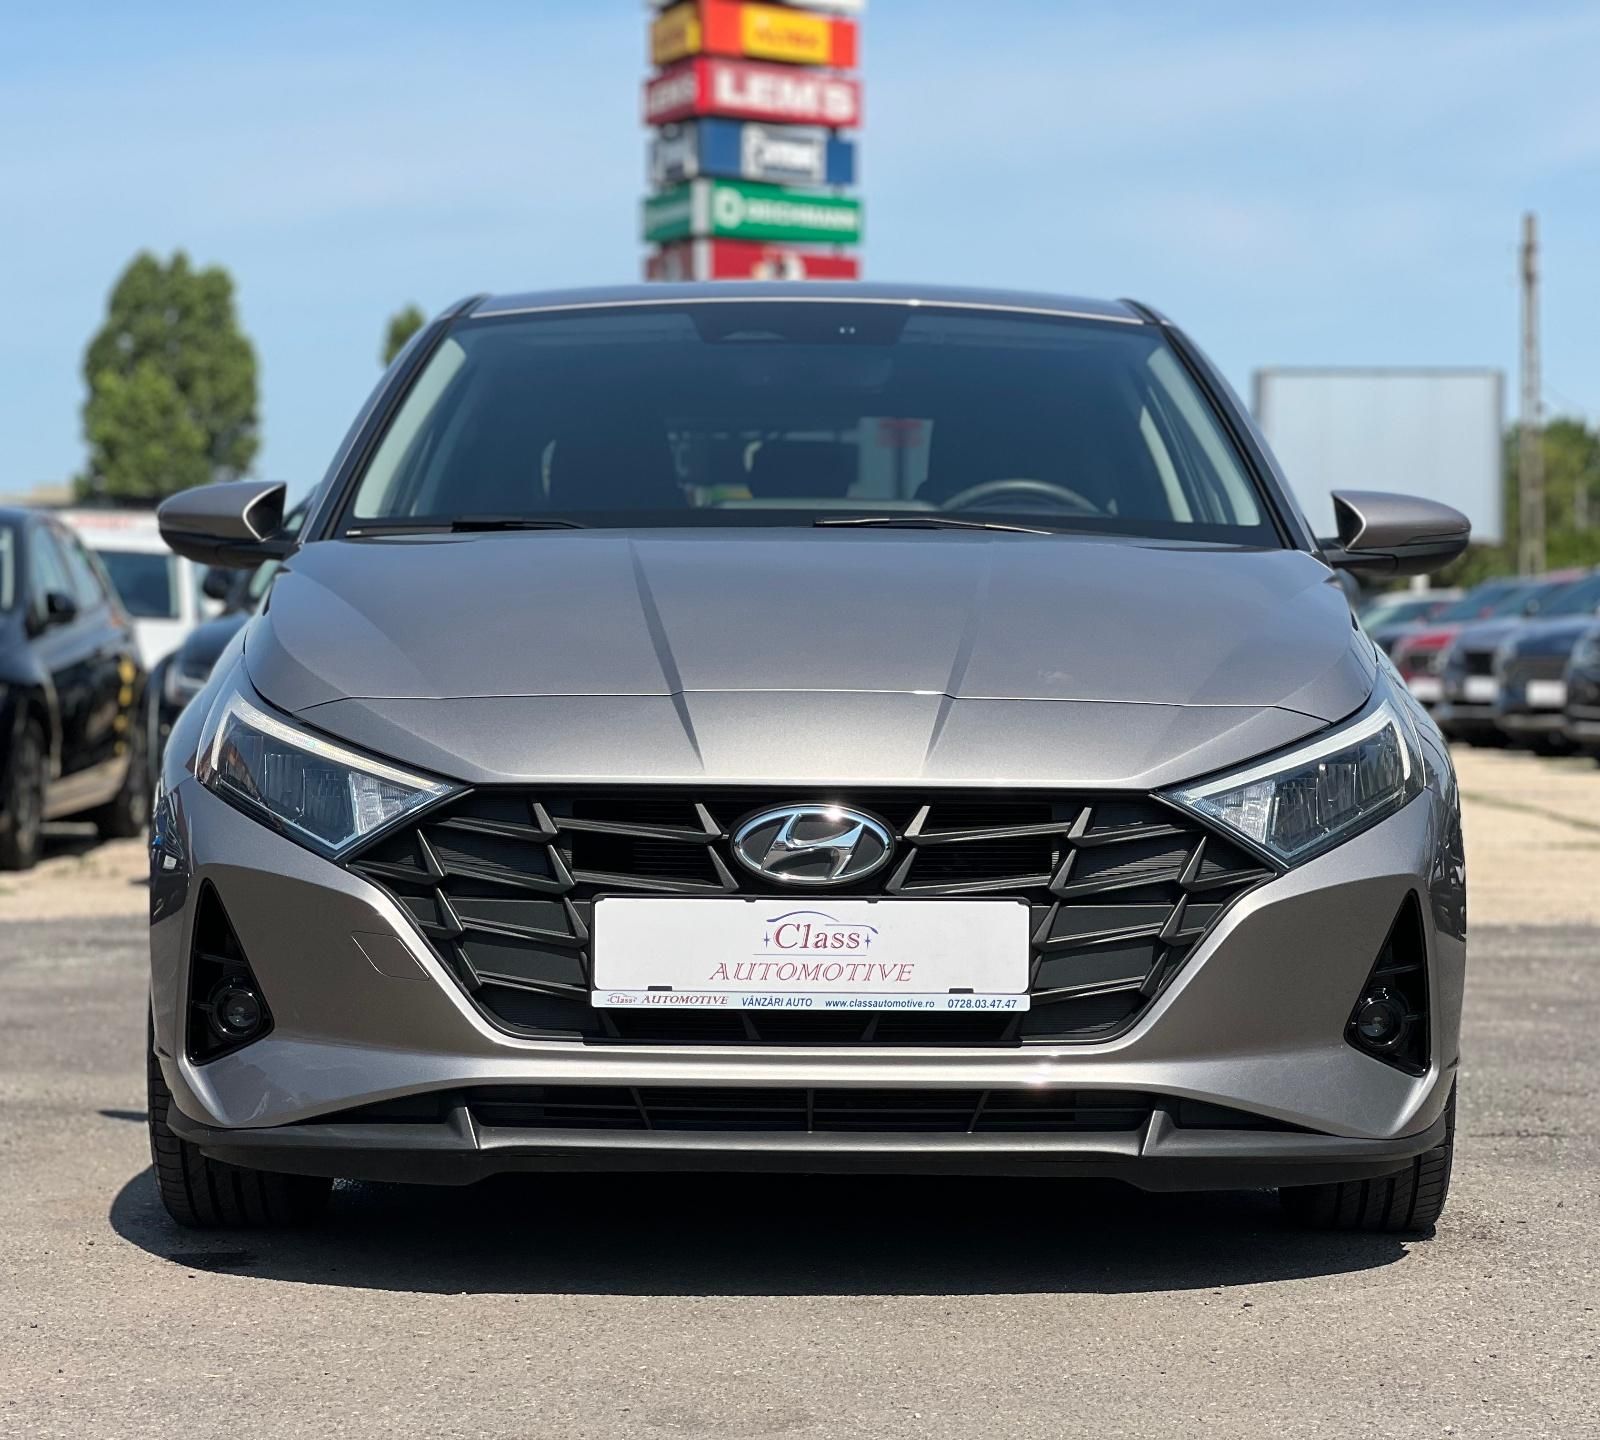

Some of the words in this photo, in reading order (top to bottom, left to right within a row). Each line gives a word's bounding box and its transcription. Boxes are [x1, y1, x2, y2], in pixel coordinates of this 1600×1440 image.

[773, 922, 861, 949] Class
[708, 962, 914, 982] AUTOMOTIVE
[609, 994, 634, 1005] Class
[642, 993, 728, 1005] AUTOMOTIVE
[785, 997, 813, 1007] AUTO
[825, 997, 935, 1009] www.classautomotive.ro
[947, 998, 1017, 1009] 0728.03.47.47
